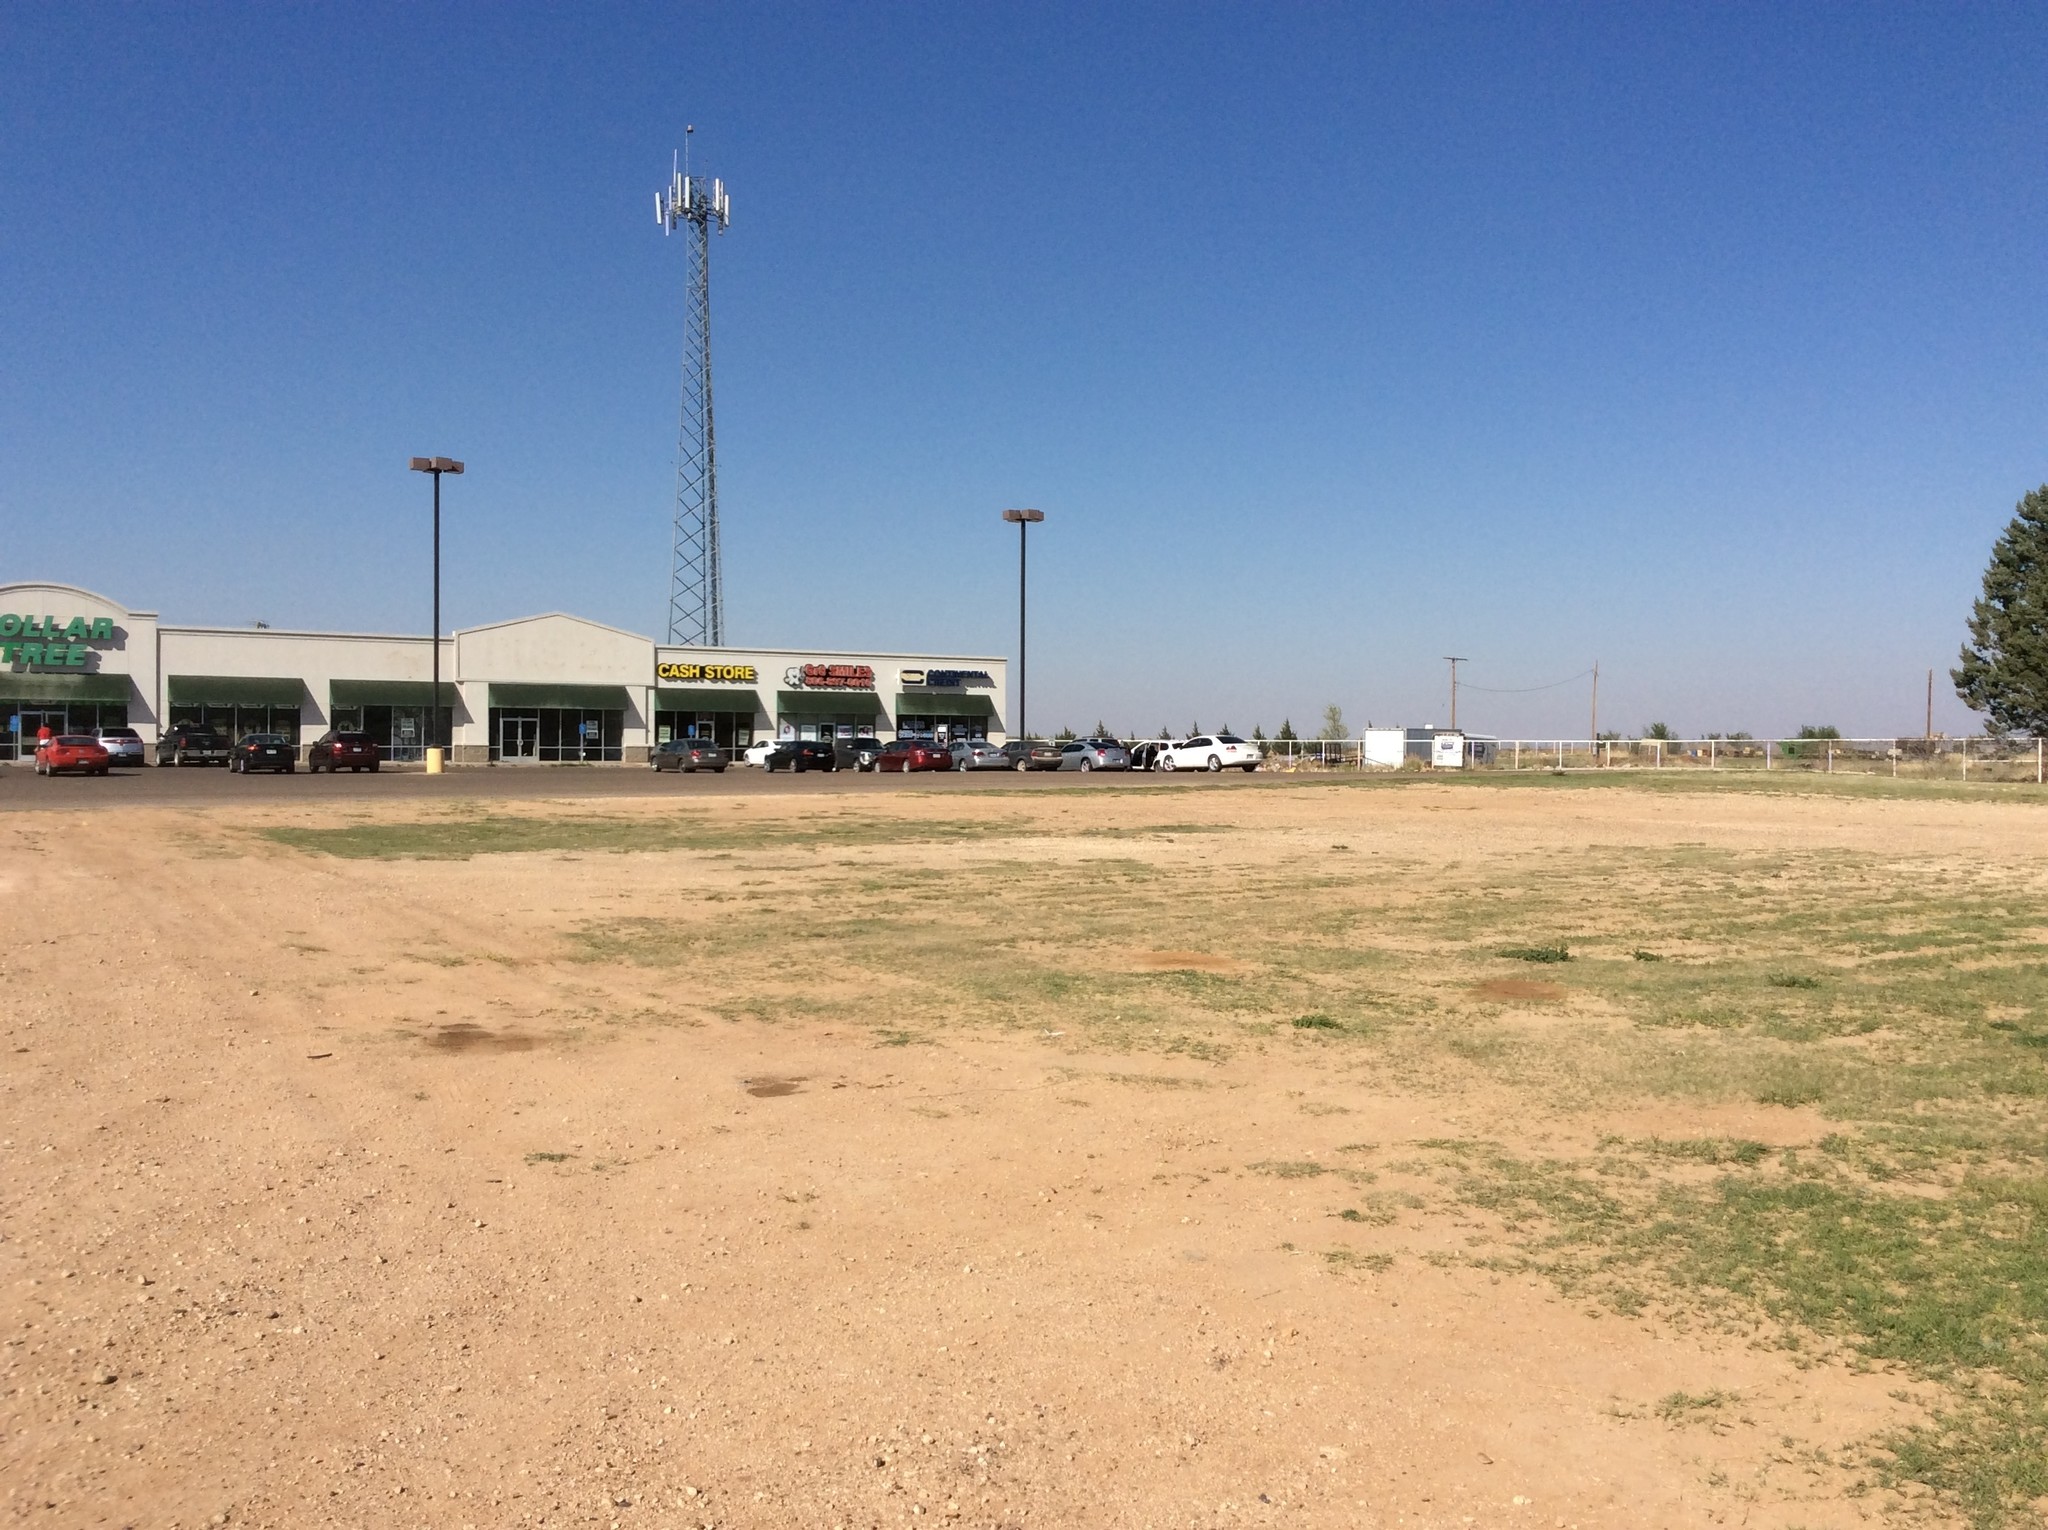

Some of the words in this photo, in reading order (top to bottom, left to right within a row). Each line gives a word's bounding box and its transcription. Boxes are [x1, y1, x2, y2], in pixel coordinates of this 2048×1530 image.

[0, 641, 88, 666] TREE
[658, 664, 700, 678] CASH
[704, 665, 754, 680] STORE
[828, 665, 872, 678] SMILES
[927, 669, 990, 679] CONTINENTAL
[927, 678, 960, 687] CREDIT
